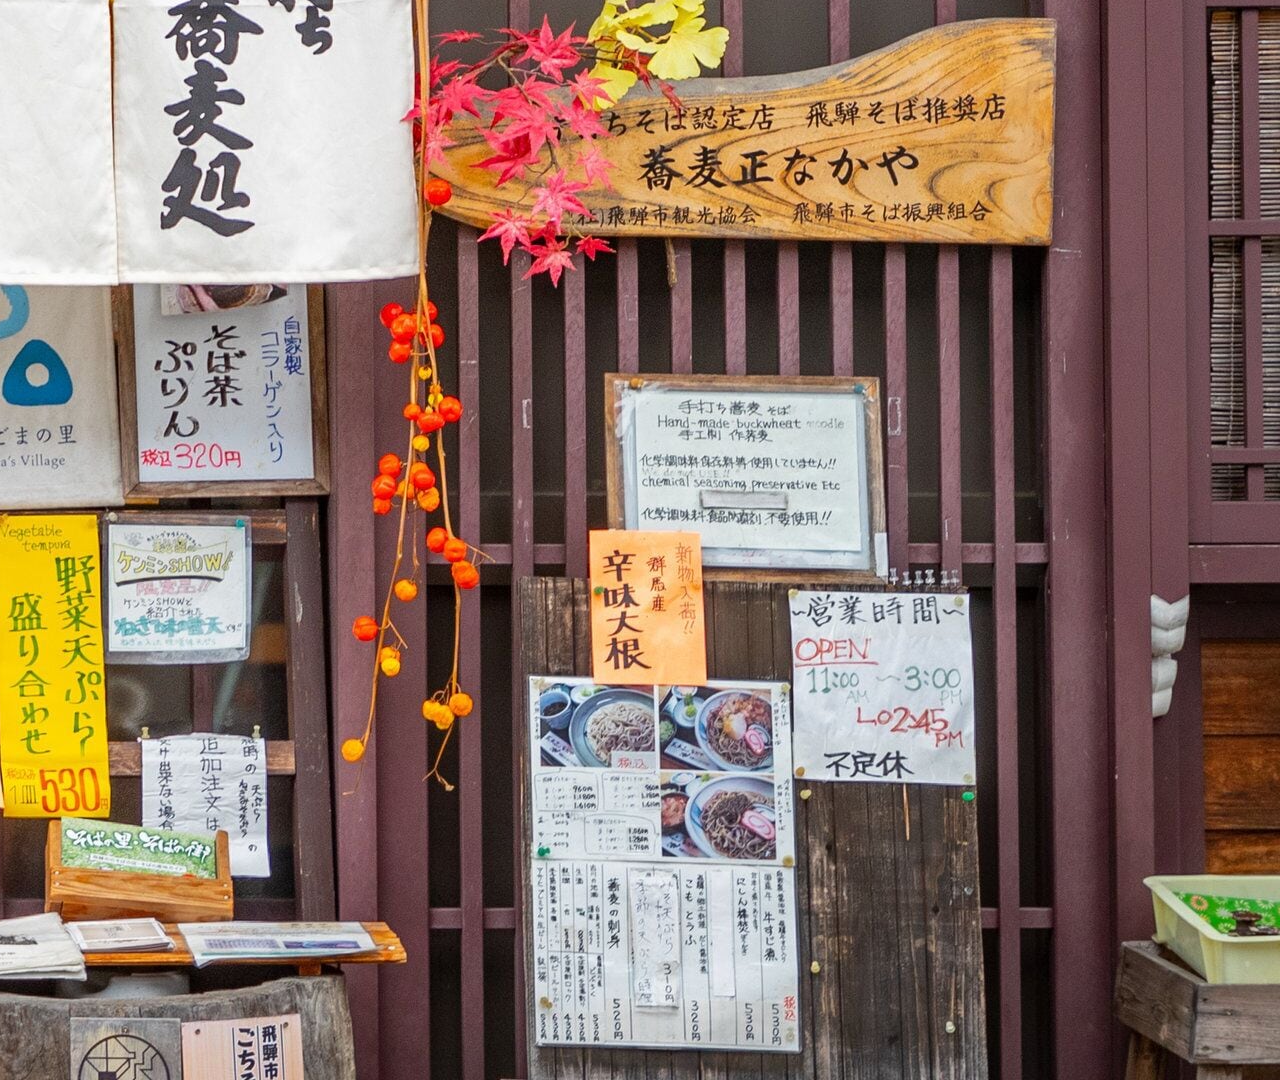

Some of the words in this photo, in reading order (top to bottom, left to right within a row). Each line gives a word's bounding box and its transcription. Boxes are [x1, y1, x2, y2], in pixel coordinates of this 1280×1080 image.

[806, 93, 1007, 129] 飛騨そば推奨店
[637, 144, 920, 191] 蕎麦正なかや
[792, 200, 993, 224] 飛騨市そば振興組合
[284, 315, 304, 376] 自家製
[202, 325, 247, 408] そば茶
[154, 340, 200, 438] ぷりん
[260, 331, 284, 463] コラーゲン入り
[657, 415, 730, 429] Hand-made
[736, 414, 801, 429] buckwheat
[20, 453, 66, 468] Village
[642, 476, 690, 488] chemical
[751, 478, 817, 493] preservative
[822, 481, 841, 492] Etc
[0, 524, 63, 539] Vegetable
[22, 539, 72, 554] tempura
[646, 555, 667, 612] 群馬産
[145, 606, 204, 619] 紹介された
[603, 549, 652, 670] 辛味大根
[54, 554, 101, 758] 野菜天ぷら
[795, 637, 872, 663] OPEN
[8, 592, 51, 755] 盛り合わせ
[806, 666, 860, 694] 11:00
[904, 665, 962, 692] 3:00
[844, 690, 870, 705] AM
[940, 689, 963, 707] PM
[934, 730, 965, 749] PM
[617, 756, 648, 769] 税込
[824, 750, 915, 779] 不定休
[40, 767, 109, 813] 530円
[198, 737, 227, 832] 追加注文は
[247, 843, 258, 853] の
[607, 878, 621, 950] 蕎麦の刺身
[663, 963, 675, 1003] 310円
[612, 998, 624, 1040] 520円
[691, 1000, 701, 1041] 320円
[745, 1003, 755, 1040] 530円
[771, 1003, 782, 1045] 530円
[783, 995, 796, 1021] 税込
[578, 1013, 586, 1041] 430円
